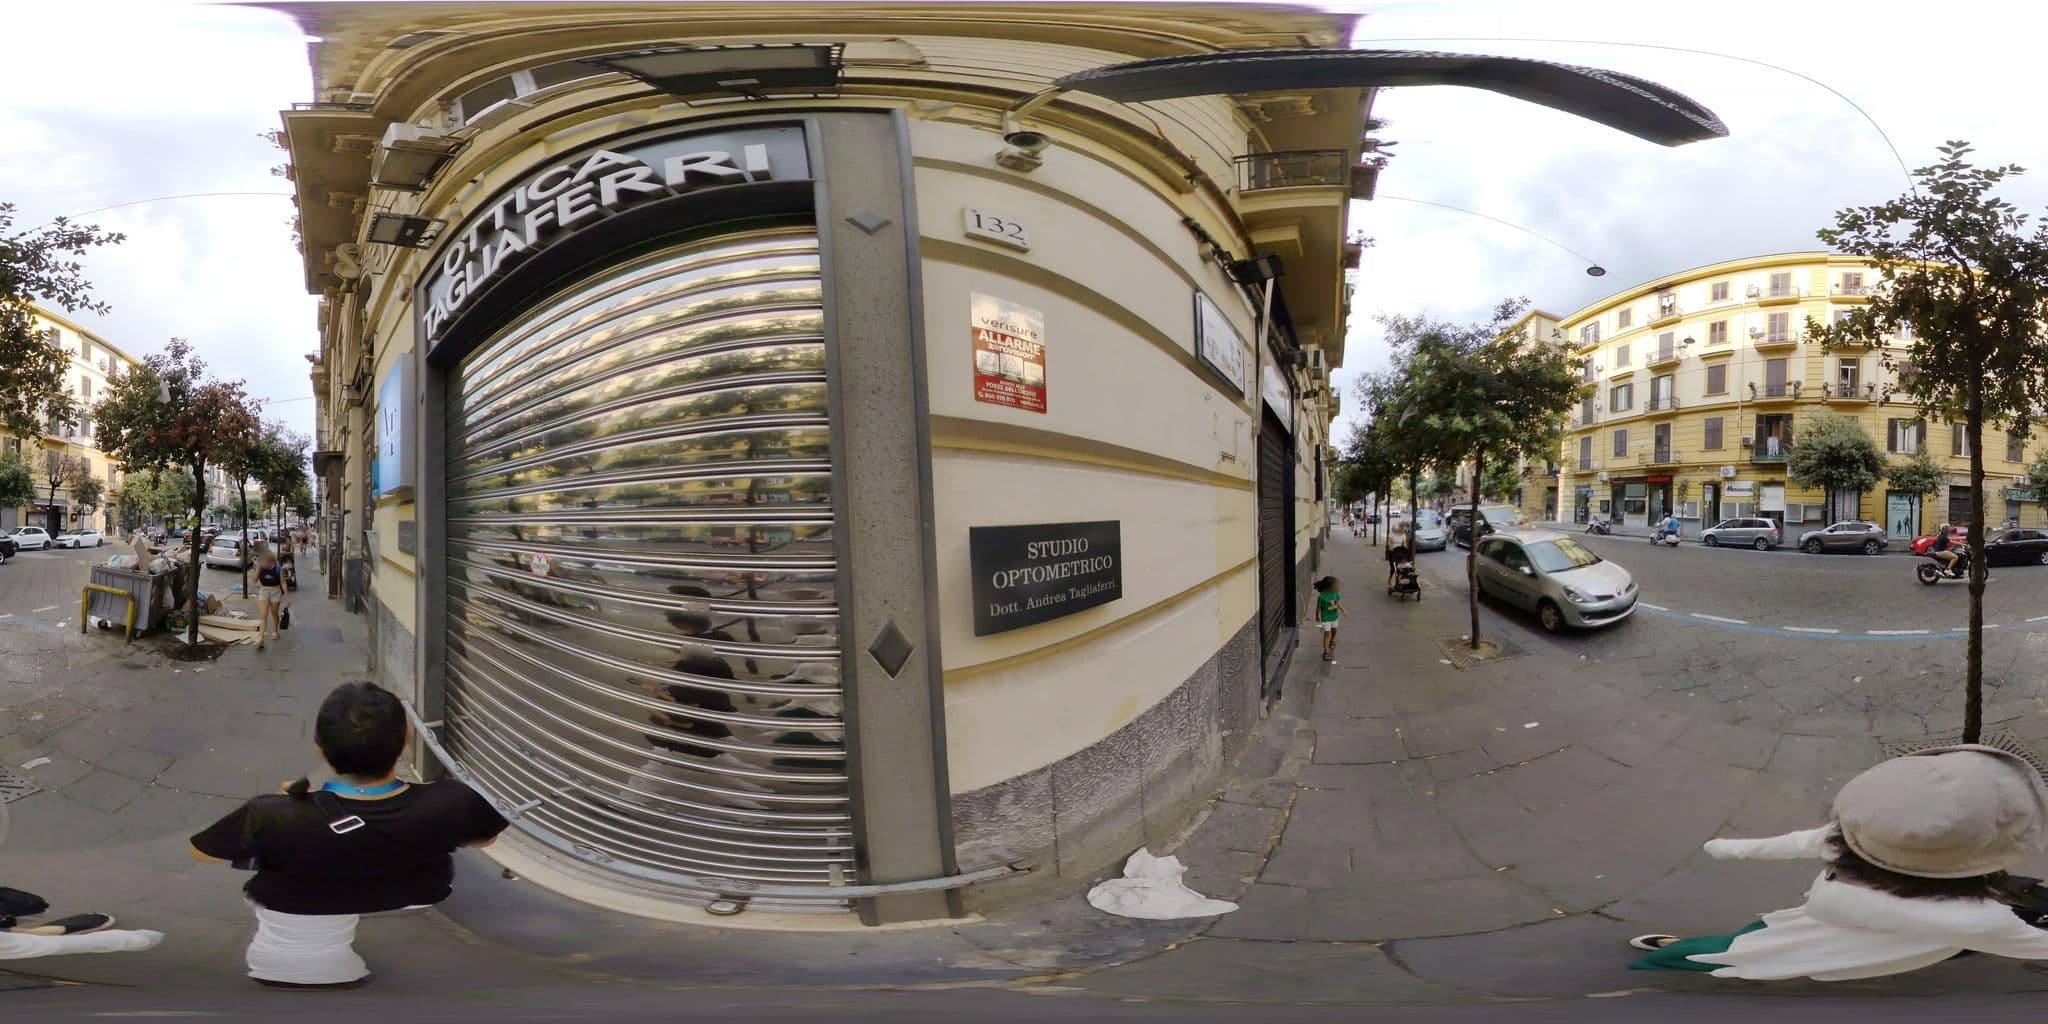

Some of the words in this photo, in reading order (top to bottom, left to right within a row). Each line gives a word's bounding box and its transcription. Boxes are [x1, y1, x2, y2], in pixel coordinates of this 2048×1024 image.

[443, 149, 648, 277] OTTICA
[975, 214, 1023, 240] 132
[423, 144, 771, 340] TAGLIAFERRI
[979, 329, 1041, 356] ALLARME
[981, 317, 1038, 339] verisure
[1027, 537, 1089, 560] STUDIO
[992, 555, 1113, 589] OPTOMETRICO
[990, 603, 1023, 617] Dott.
[1026, 594, 1067, 610] Andrea
[1069, 579, 1116, 600] Tagliaferri
